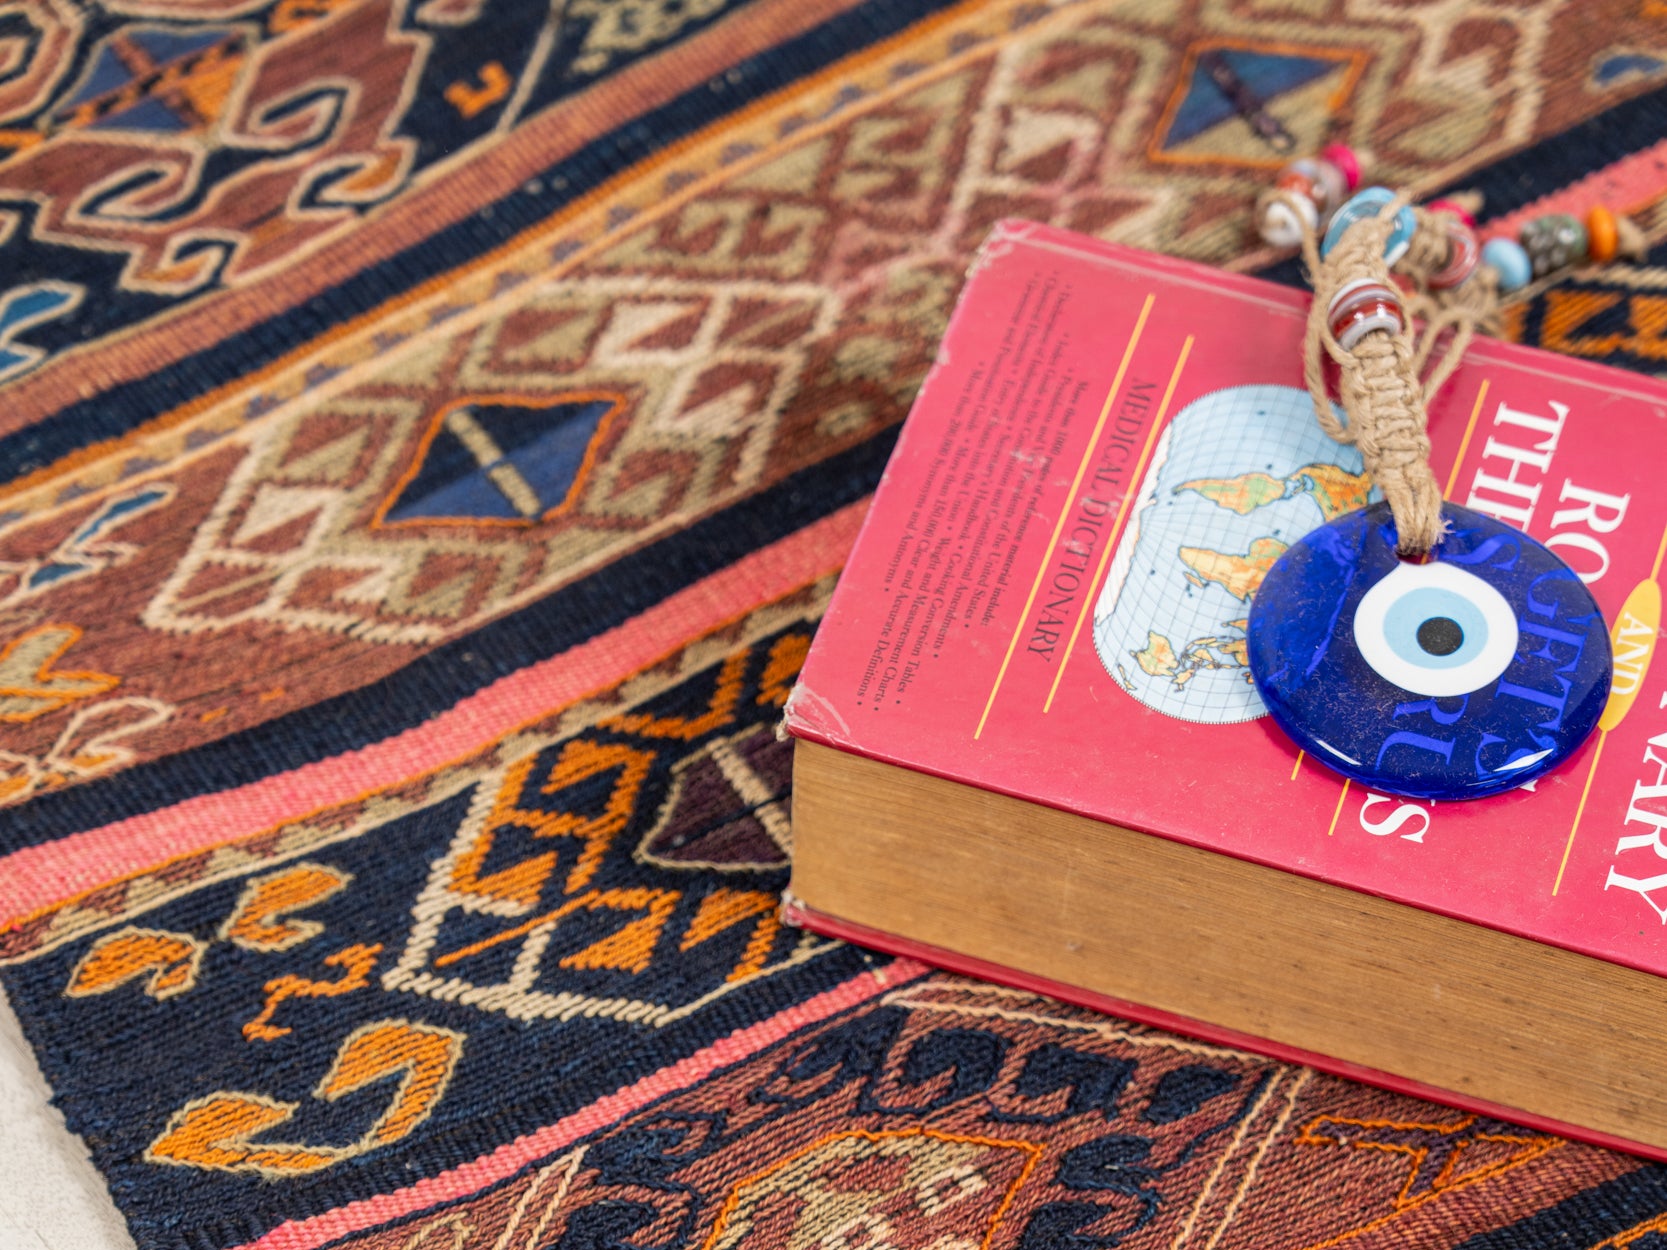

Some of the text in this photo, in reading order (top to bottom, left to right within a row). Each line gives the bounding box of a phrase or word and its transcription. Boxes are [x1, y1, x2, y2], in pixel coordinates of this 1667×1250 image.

[938, 473, 957, 497] than
[979, 380, 1088, 627] More than 1000 pages of reference material include:
[989, 488, 1006, 508] and
[906, 511, 923, 530] and
[957, 488, 988, 542] Handbook
[999, 520, 1013, 532] of
[1023, 377, 1159, 662] MEDICAL DICTIONARY
[881, 532, 914, 585] Antonyms
[909, 538, 930, 568] Clear
[925, 535, 951, 571] Weight
[959, 509, 998, 581] Constitutional
[992, 532, 1008, 549] the
[900, 569, 917, 589] and
[918, 572, 935, 593] and
[934, 551, 962, 596] Cooking
[976, 550, 1000, 587] United
[880, 590, 909, 638] Accurate
[932, 582, 969, 651] Amendments
[963, 588, 986, 620] States
[888, 593, 927, 664] Measurement
[910, 596, 945, 657] Conversion
[856, 639, 889, 698] Definitions
[1610, 612, 1655, 695] AND
[872, 665, 898, 704] Charts
[895, 658, 920, 694] Tables
